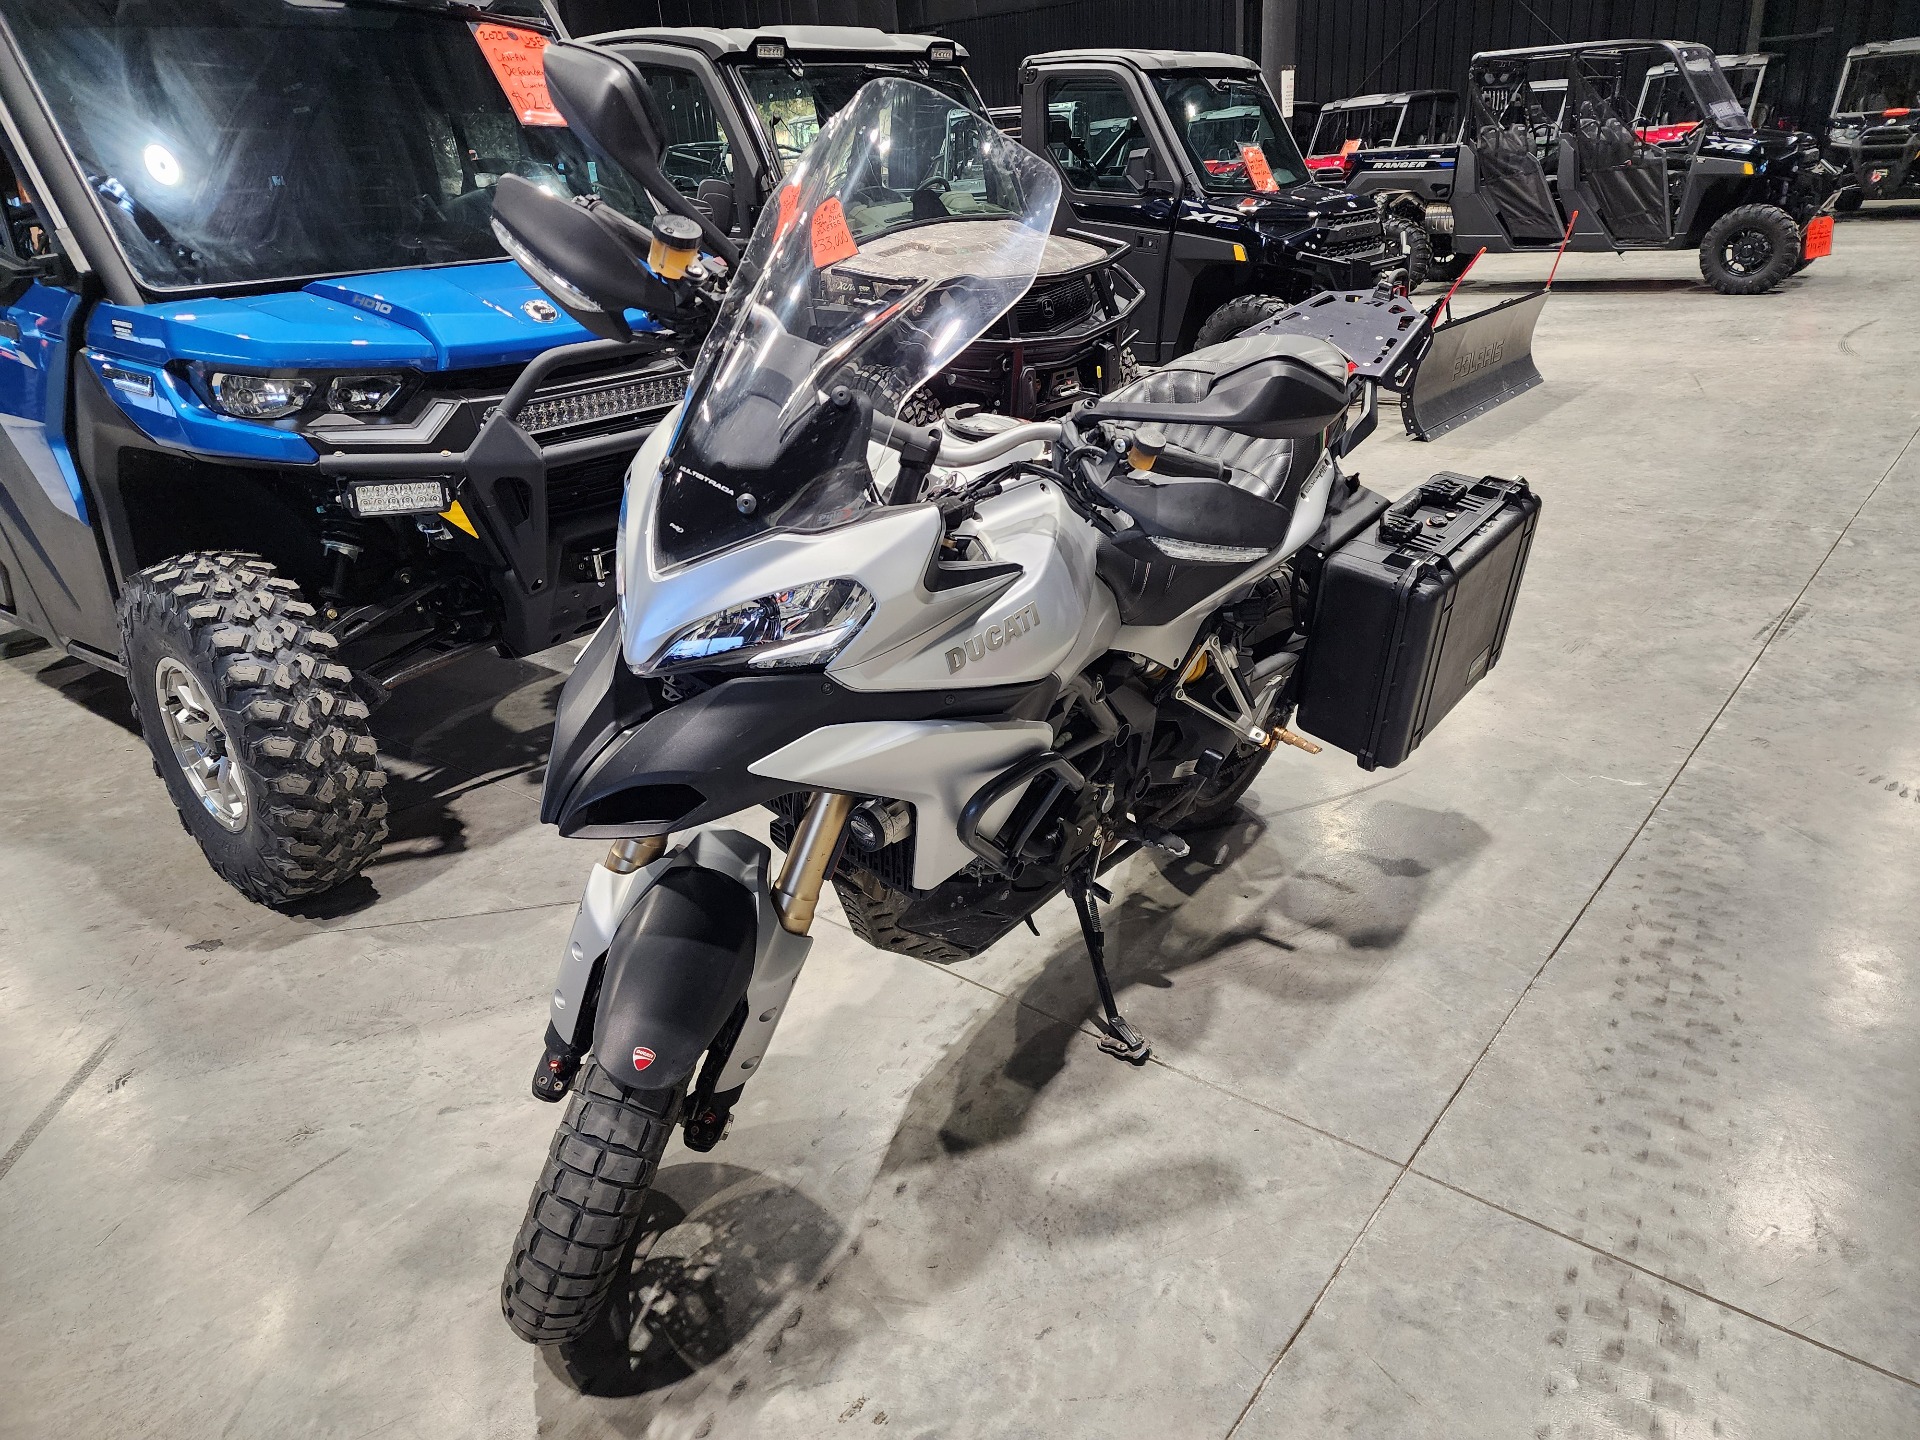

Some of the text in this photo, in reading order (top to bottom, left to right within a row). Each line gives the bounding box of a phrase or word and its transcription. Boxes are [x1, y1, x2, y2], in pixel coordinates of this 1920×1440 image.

[479, 30, 508, 41] 2022
[1372, 161, 1428, 169] RANGER
[1181, 210, 1239, 224] XP
[352, 294, 393, 315] HD10
[1451, 338, 1506, 382] POLARIS
[678, 465, 735, 496] MULTISTRADA
[944, 600, 1041, 676] DUCATI
[635, 1049, 654, 1059] DUCATI
